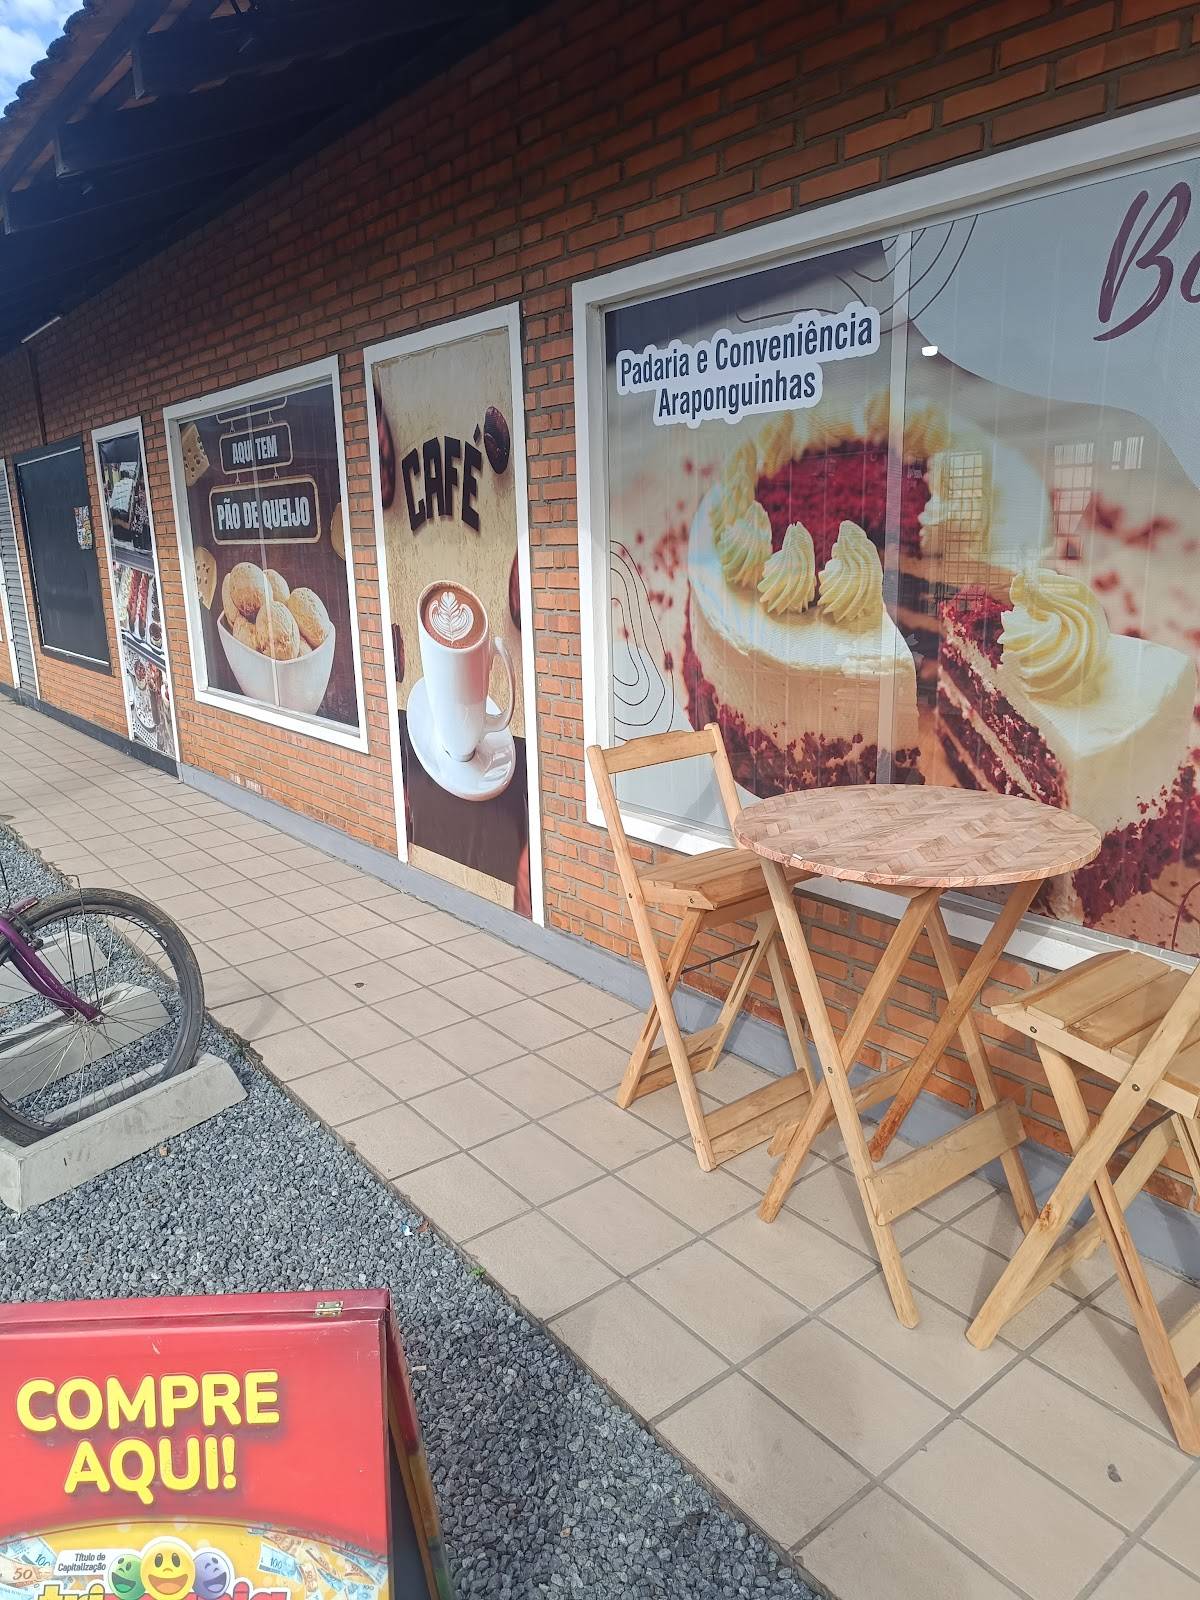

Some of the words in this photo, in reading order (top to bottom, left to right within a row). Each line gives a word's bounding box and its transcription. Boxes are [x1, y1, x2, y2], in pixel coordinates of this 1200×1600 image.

[621, 349, 690, 387] Padaria
[697, 347, 708, 374] e
[715, 312, 873, 370] Conveniência
[658, 370, 816, 419] Araponguinhas
[232, 439, 254, 464] AQUI
[255, 434, 279, 460] TEM
[402, 424, 482, 532] CAFÉ
[217, 498, 241, 530] PÃO
[243, 501, 260, 529] DE
[262, 497, 310, 530] QUEIJO
[16, 1371, 281, 1432] COMPRE
[64, 1435, 237, 1505] AQUI!
[13, 1567, 33, 1581] 50
[58, 1561, 107, 1574] Capitalização
[75, 1552, 95, 1562] Título
[96, 1552, 106, 1561] de
